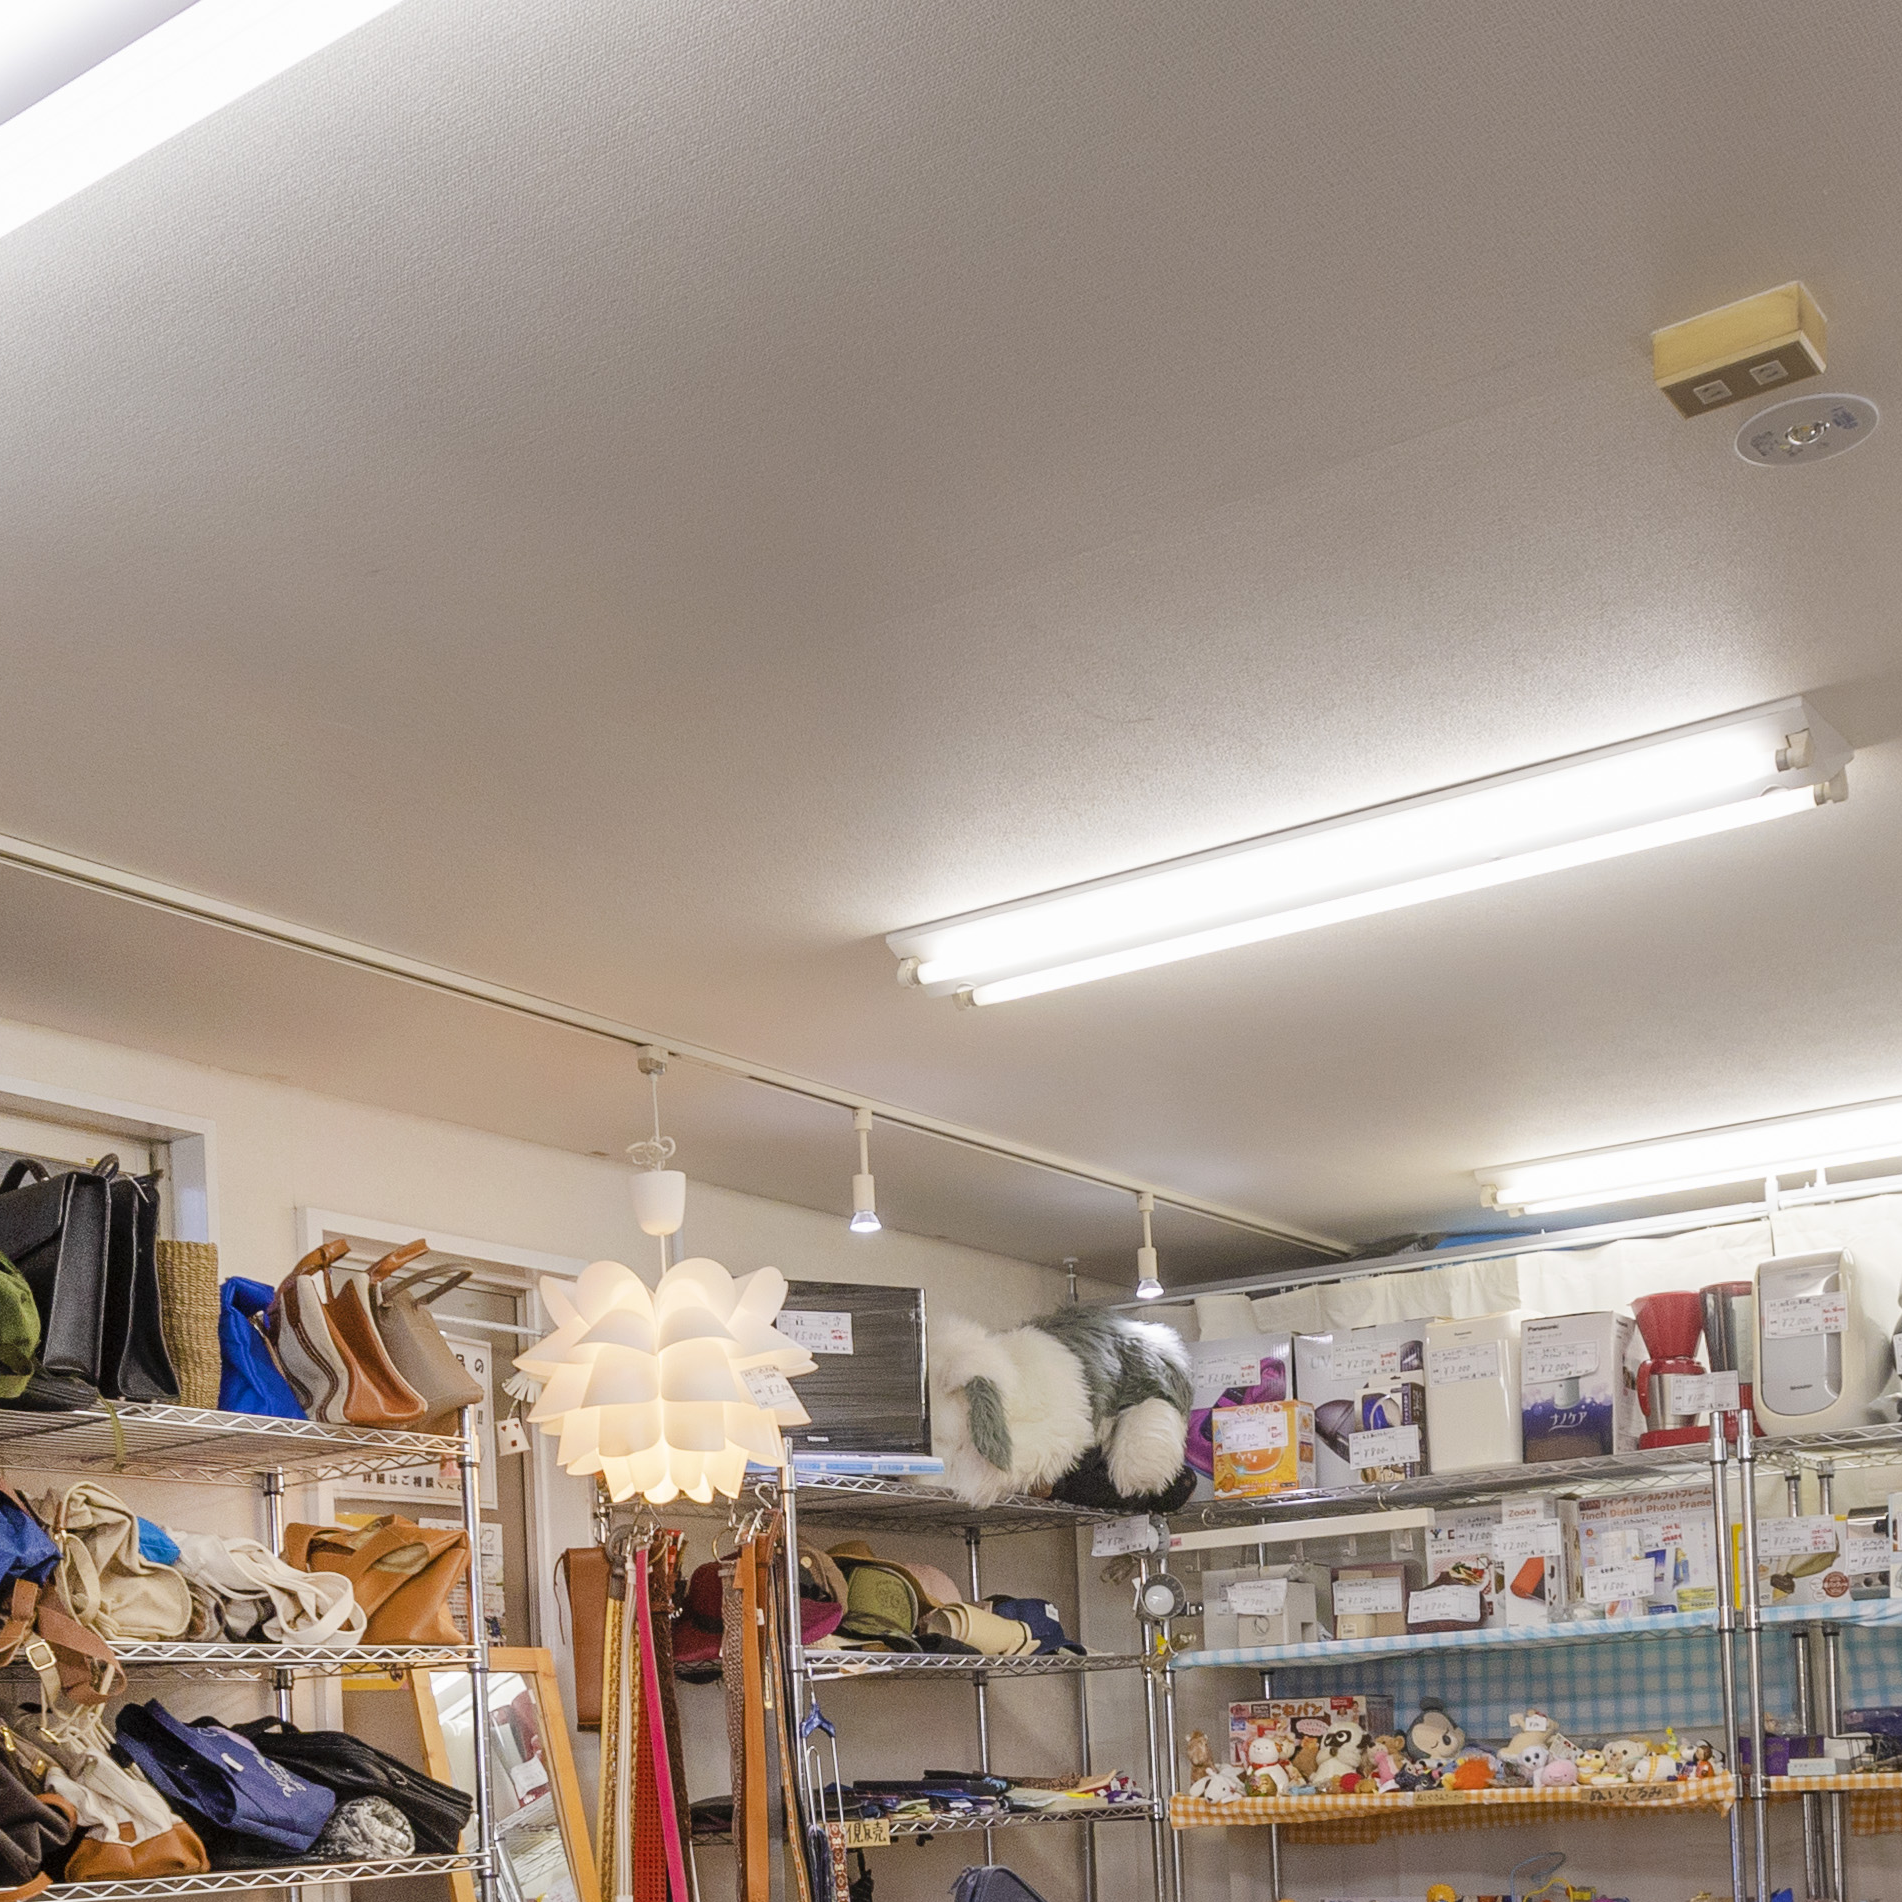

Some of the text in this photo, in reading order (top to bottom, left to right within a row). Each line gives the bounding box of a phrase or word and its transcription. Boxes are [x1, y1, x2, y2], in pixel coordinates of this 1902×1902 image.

[1526, 1323, 1560, 1333] Panasonic
[1549, 1410, 1588, 1430] ナノケア
[1507, 1507, 1538, 1519] Zooka
[1579, 1509, 1608, 1521] 7inch
[1608, 1505, 1644, 1519] Digital
[1645, 1501, 1678, 1514] Photo
[1679, 1498, 1713, 1509] Frame
